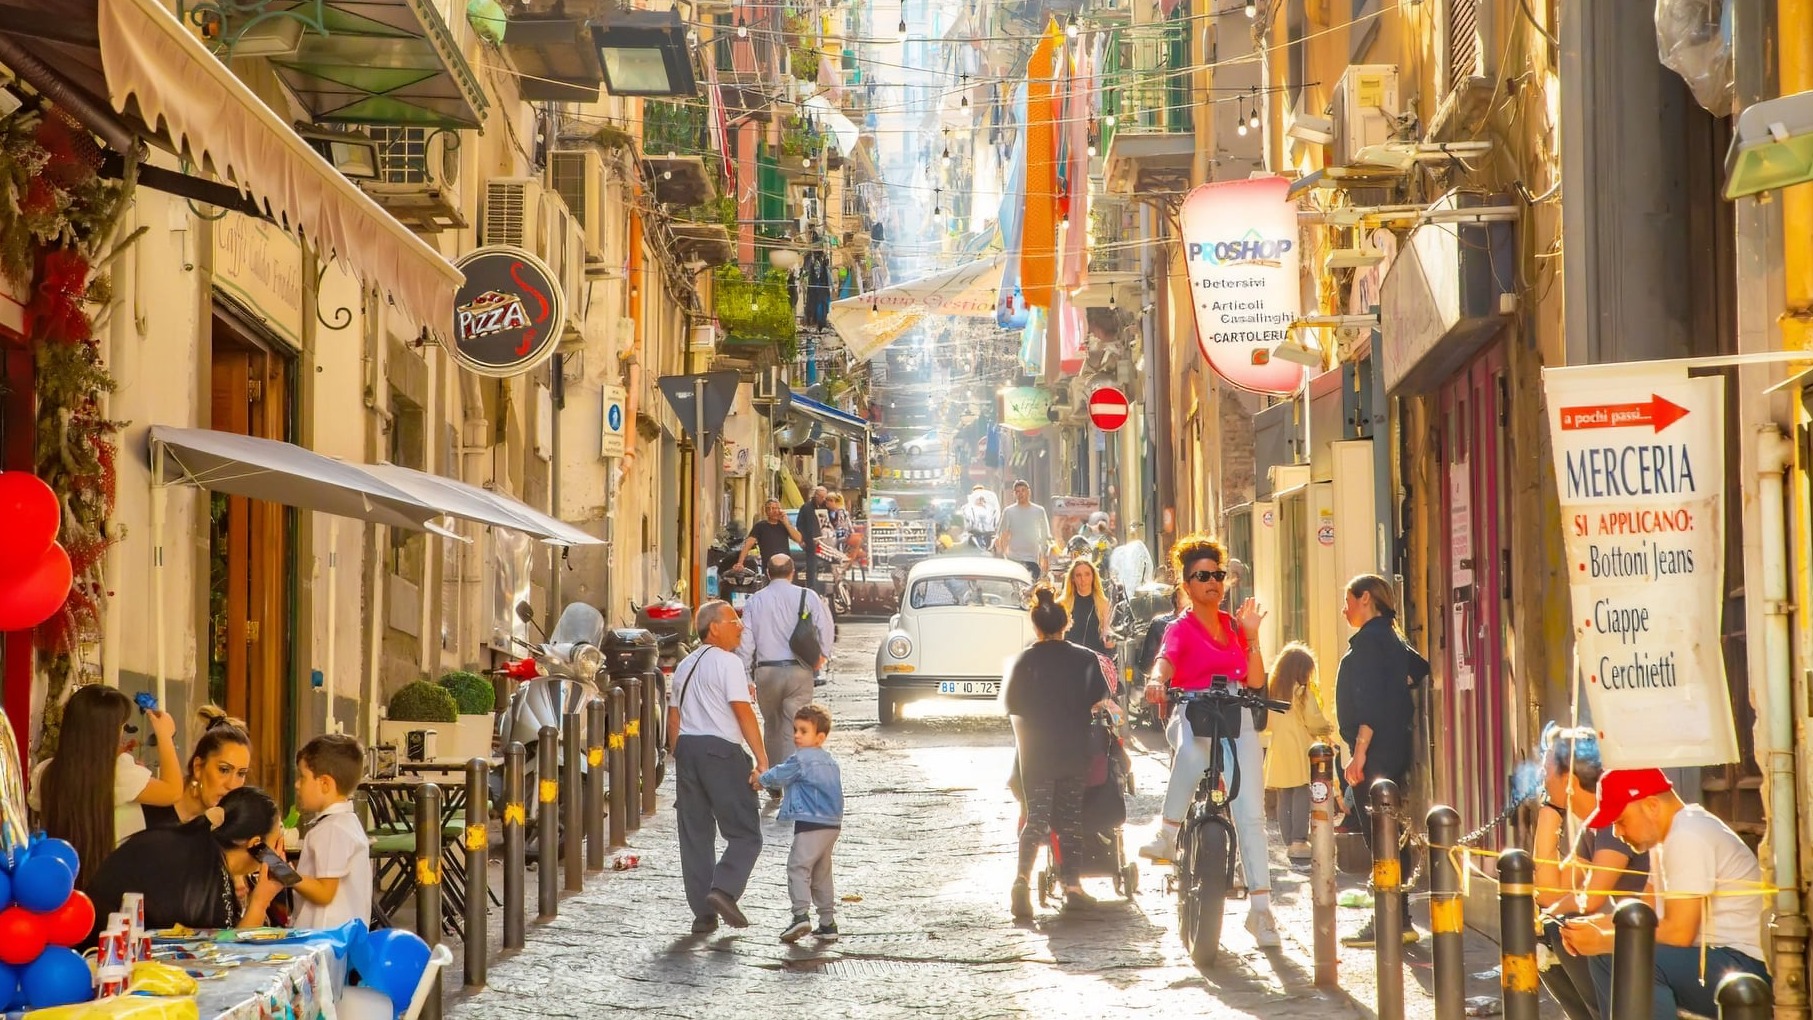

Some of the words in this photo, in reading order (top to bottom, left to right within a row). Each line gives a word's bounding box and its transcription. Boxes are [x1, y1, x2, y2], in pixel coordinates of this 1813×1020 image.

[1189, 239, 1292, 264] PROSHOP
[1203, 277, 1265, 289] Detersivi
[1212, 300, 1264, 311] Articoli
[1220, 312, 1294, 325] Casalinghi
[1564, 415, 1571, 424] a
[1575, 410, 1608, 428] pochi
[1566, 444, 1696, 499] MERCERIA
[1574, 514, 1589, 537] SI
[1598, 509, 1694, 536] APPLICANO:
[1590, 540, 1649, 578] Bottoni
[1652, 542, 1694, 582] Jeans
[1595, 598, 1649, 644] Ciappe
[1600, 651, 1677, 691] Cerchietti
